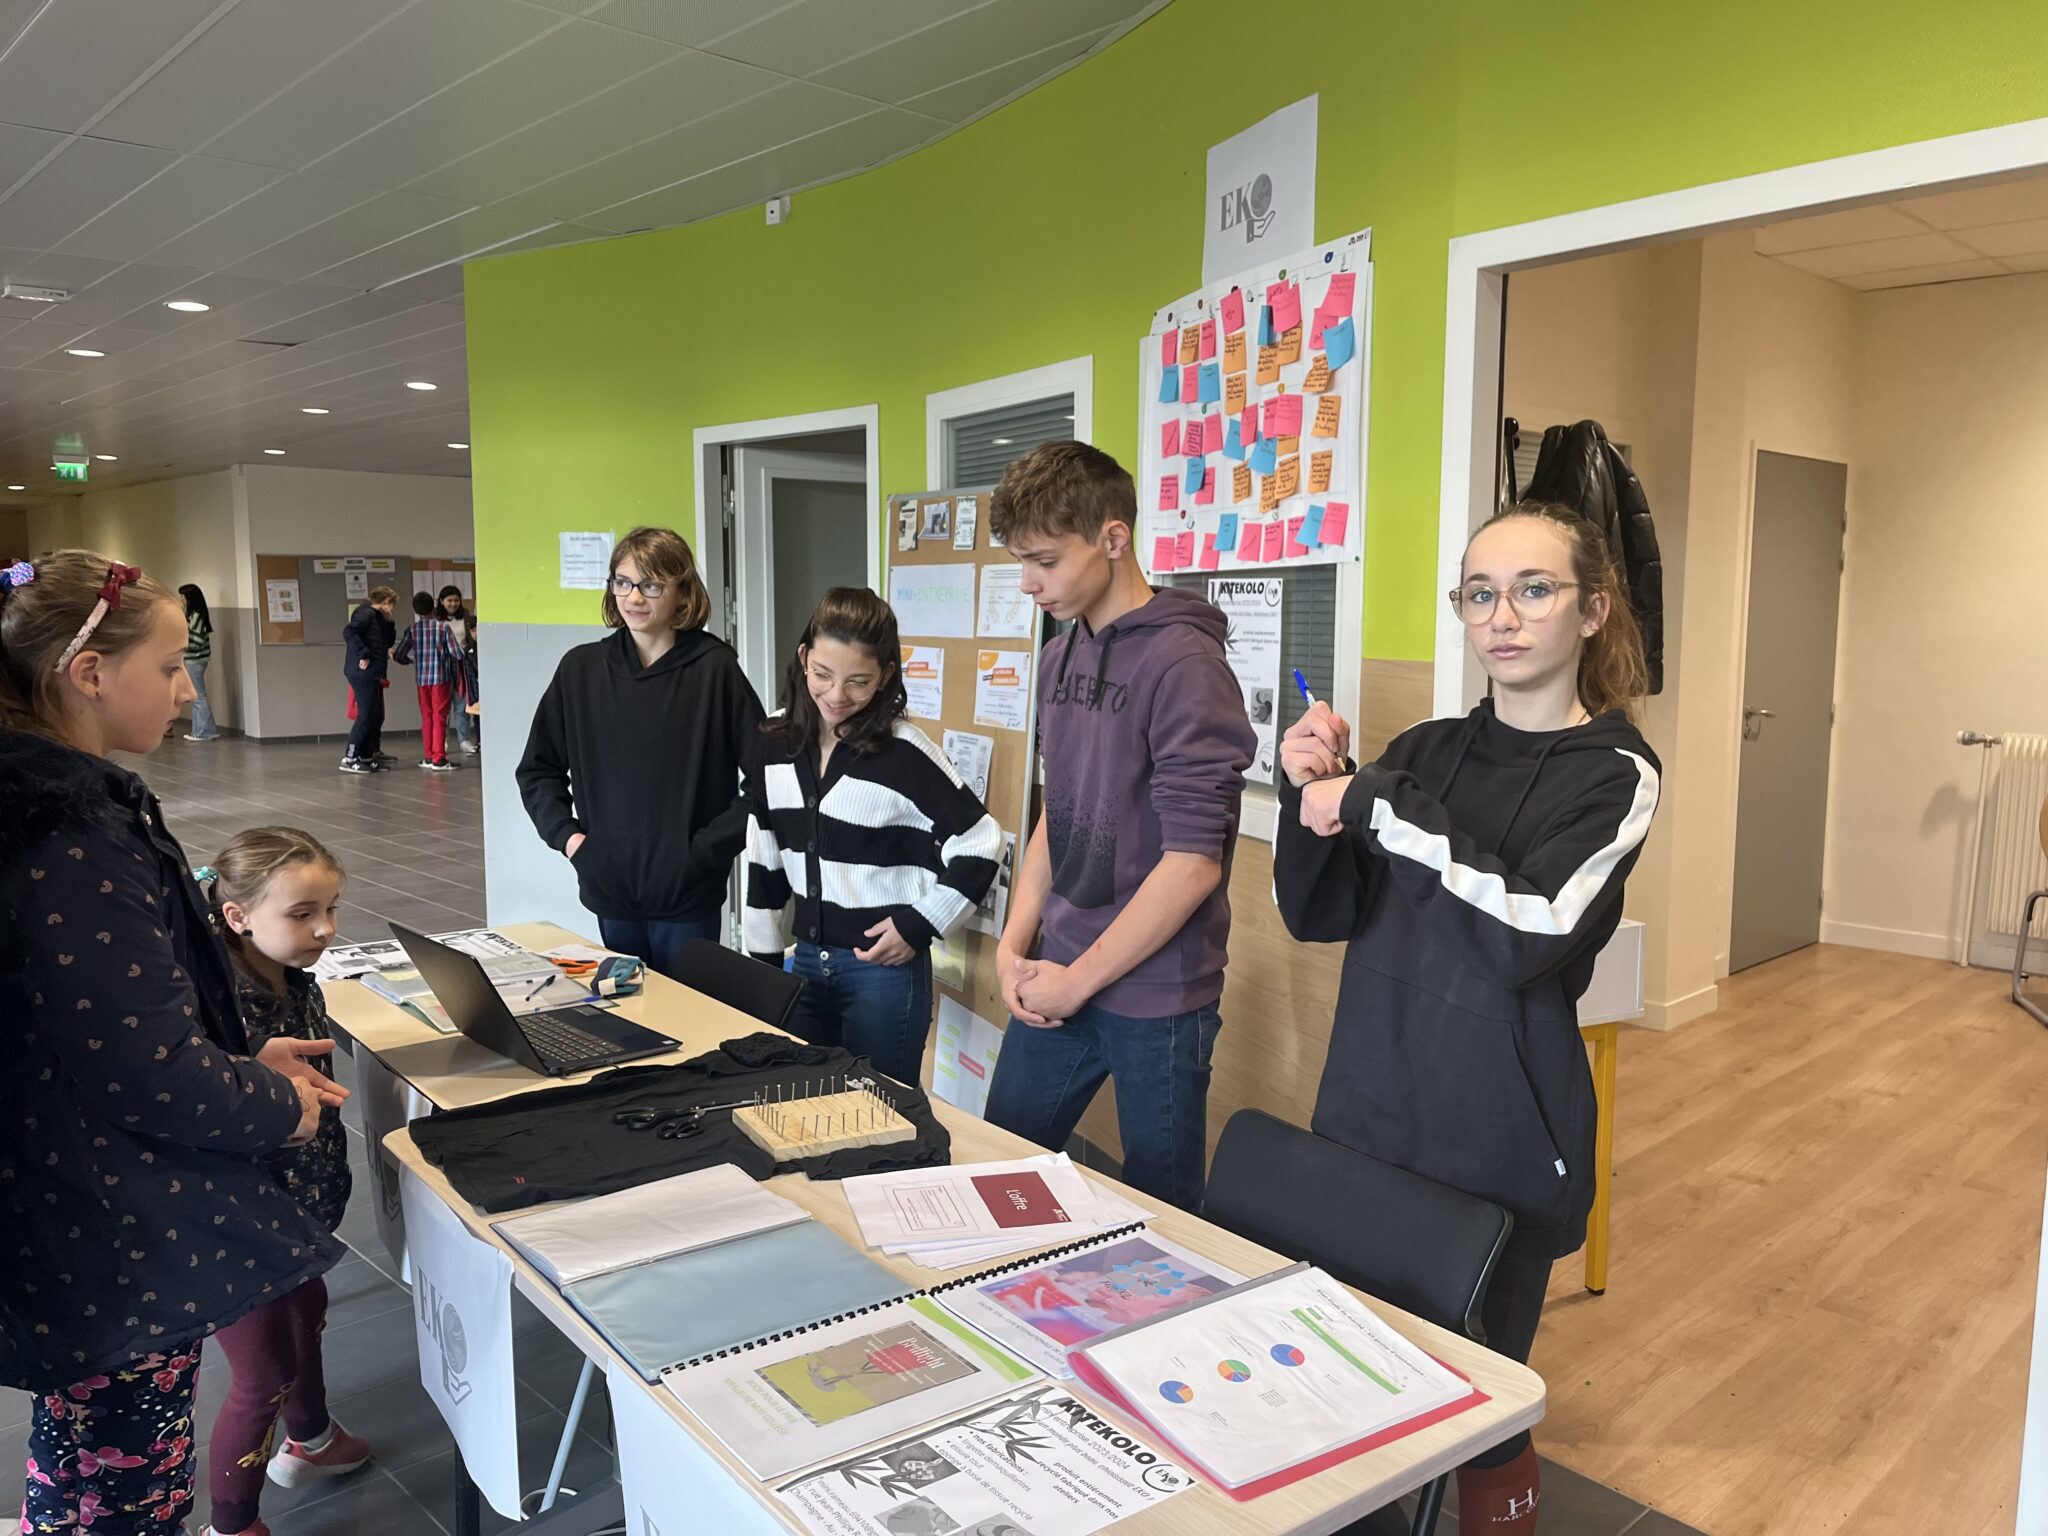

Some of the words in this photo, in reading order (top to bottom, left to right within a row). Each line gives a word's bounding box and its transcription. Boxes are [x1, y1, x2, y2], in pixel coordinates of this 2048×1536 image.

[1057, 1399, 1157, 1465] KITEKOLO
[973, 1434, 987, 1445] nos
[985, 1443, 1025, 1473] fabrications
[965, 1468, 982, 1482] base
[1053, 1462, 1081, 1481] produit
[808, 1487, 822, 1500] rue
[1052, 1484, 1080, 1504] ateliers
[1060, 1477, 1089, 1499] fabriqué
[1087, 1495, 1107, 1511] dans
[1104, 1507, 1119, 1520] nos
[789, 1487, 825, 1521] Champagne
[824, 1522, 836, 1534] Au
